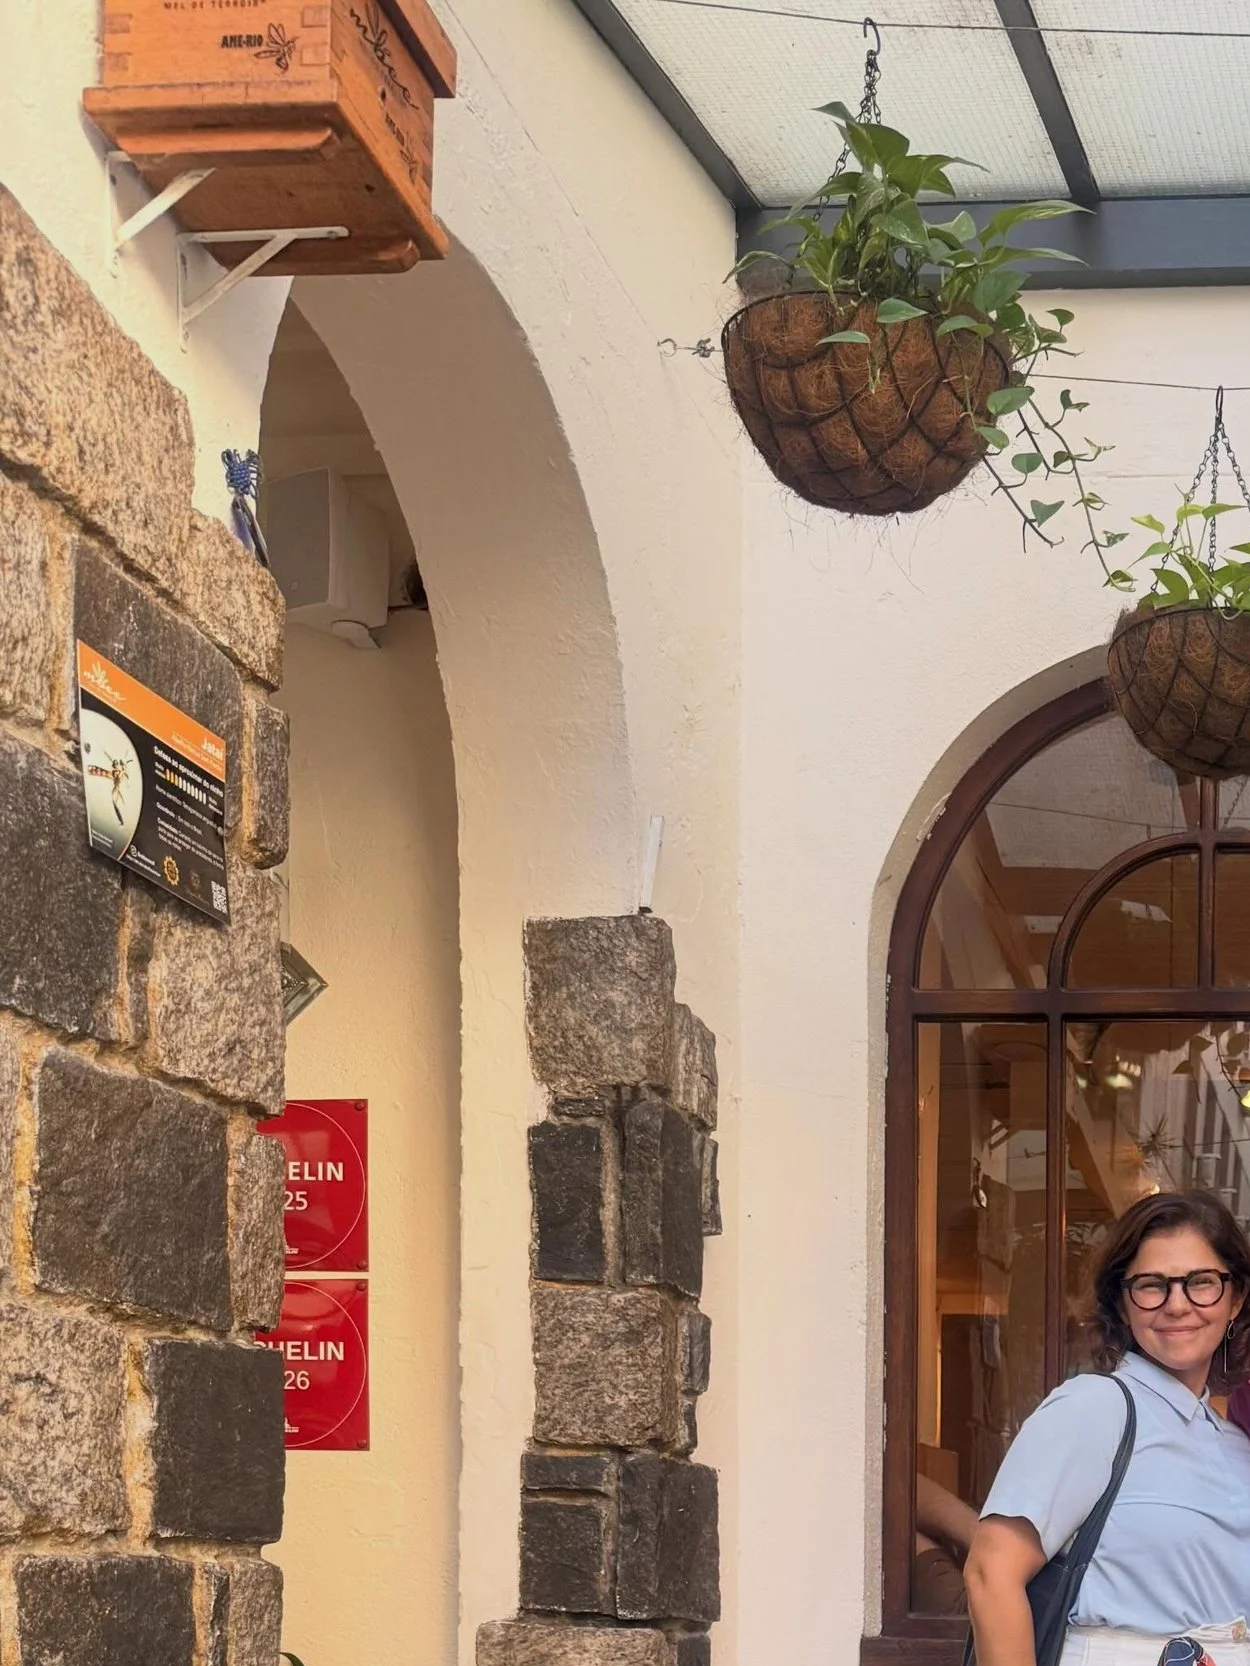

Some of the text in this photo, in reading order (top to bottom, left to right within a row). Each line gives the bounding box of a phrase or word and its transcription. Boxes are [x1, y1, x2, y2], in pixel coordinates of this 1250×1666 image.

[288, 1161, 344, 1181] ELIN
[284, 1191, 308, 1211] 25
[254, 1341, 344, 1361] ELIN
[283, 1370, 310, 1390] 26
